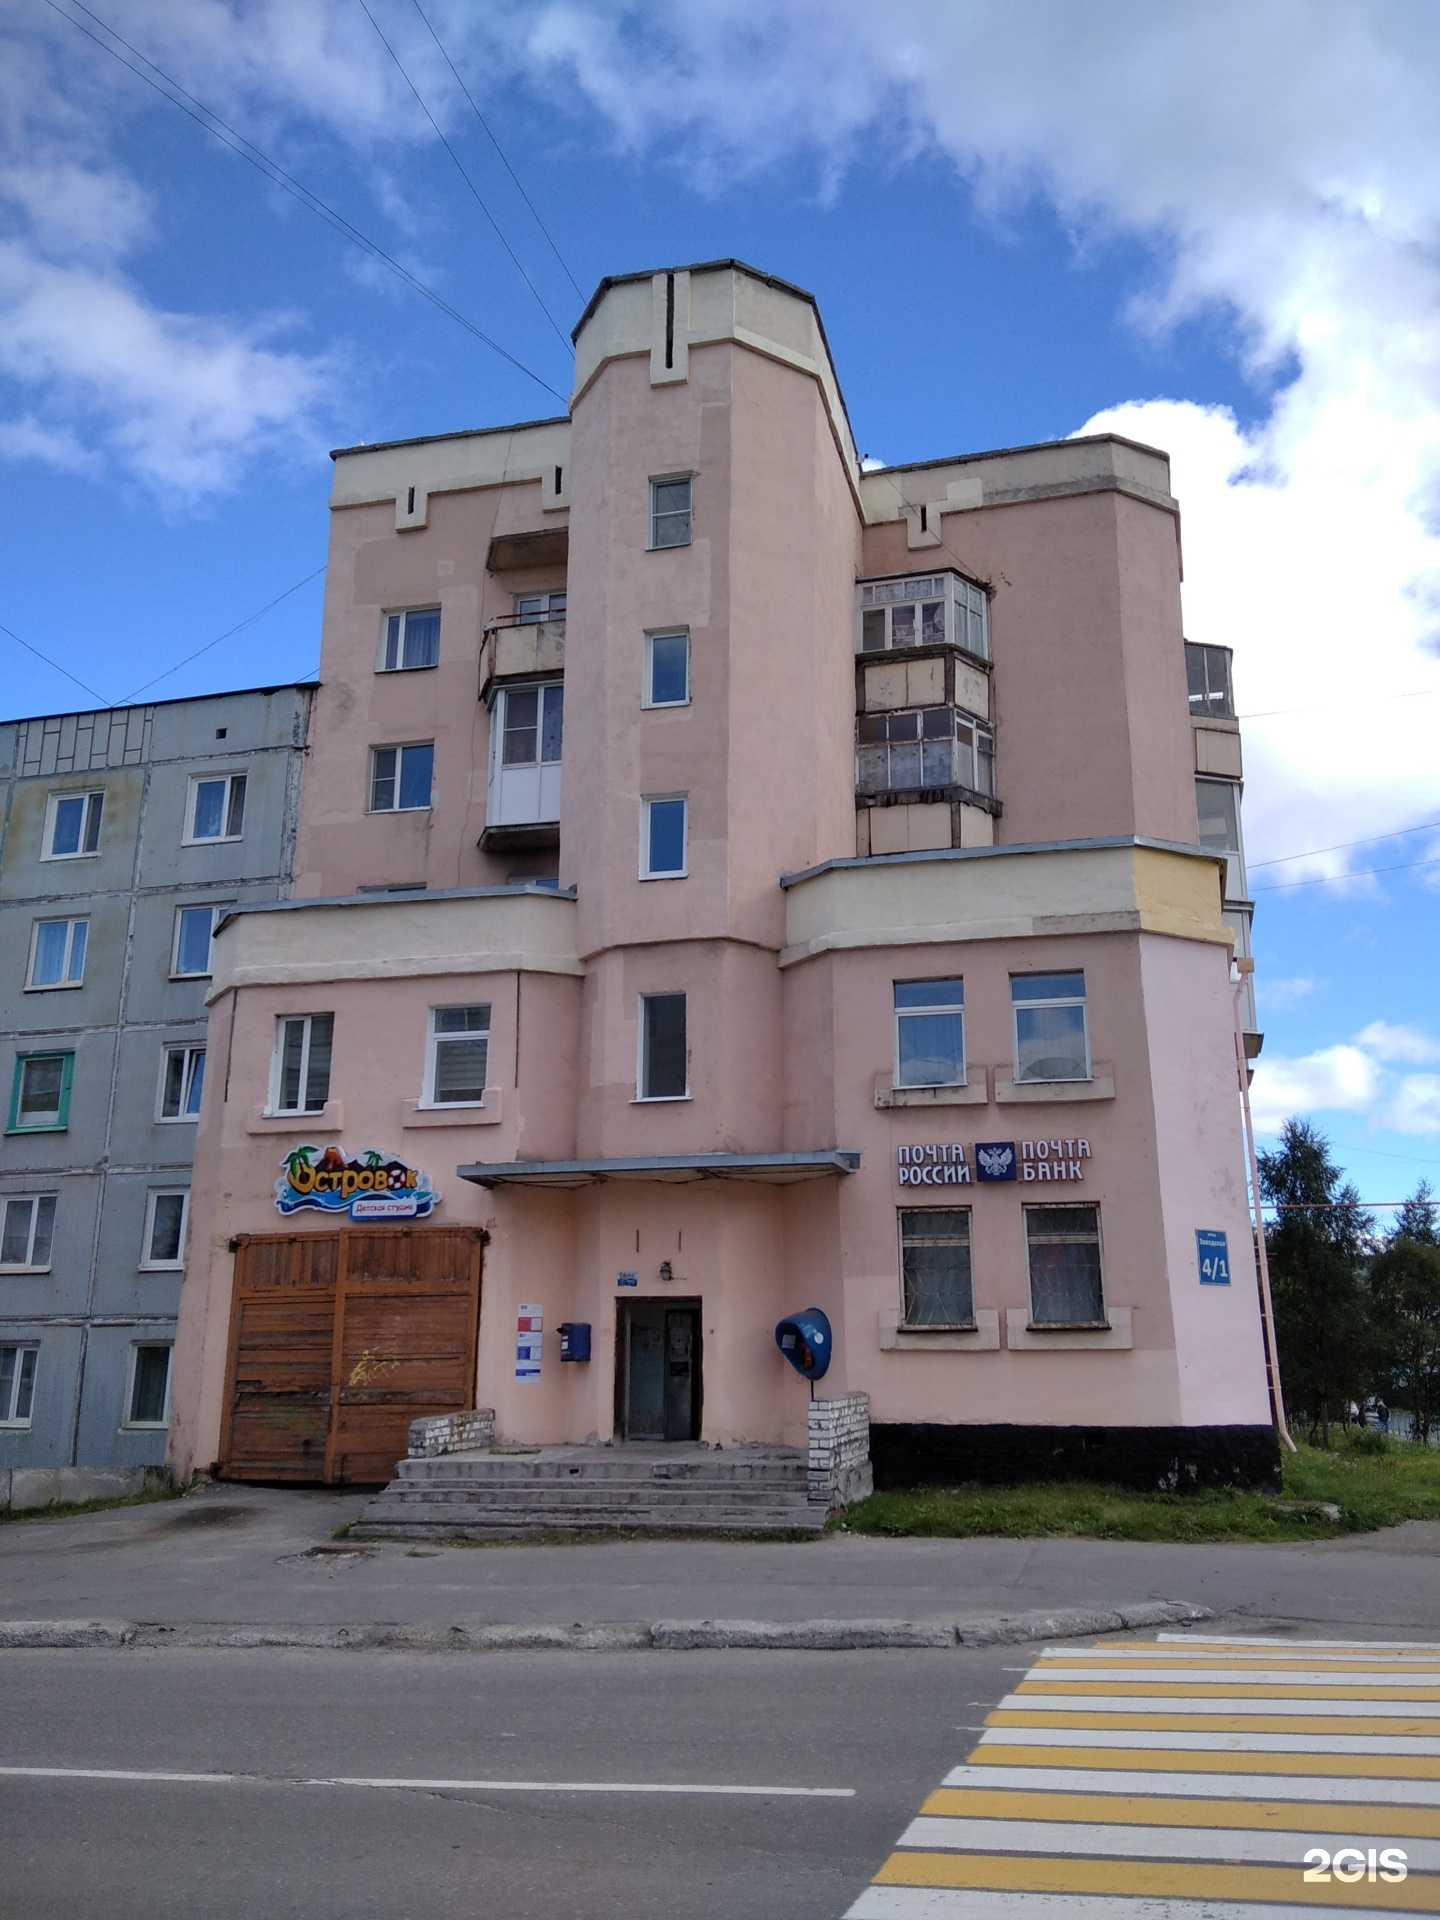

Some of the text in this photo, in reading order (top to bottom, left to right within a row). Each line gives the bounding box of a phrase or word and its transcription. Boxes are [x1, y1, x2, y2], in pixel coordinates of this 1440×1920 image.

[897, 1143, 966, 1164] ПОЧТА
[1021, 1138, 1092, 1160] ПОЧТА
[898, 1164, 971, 1185] РОССИИ
[1023, 1160, 1084, 1181] БАНК
[1202, 1256, 1228, 1280] 4/1
